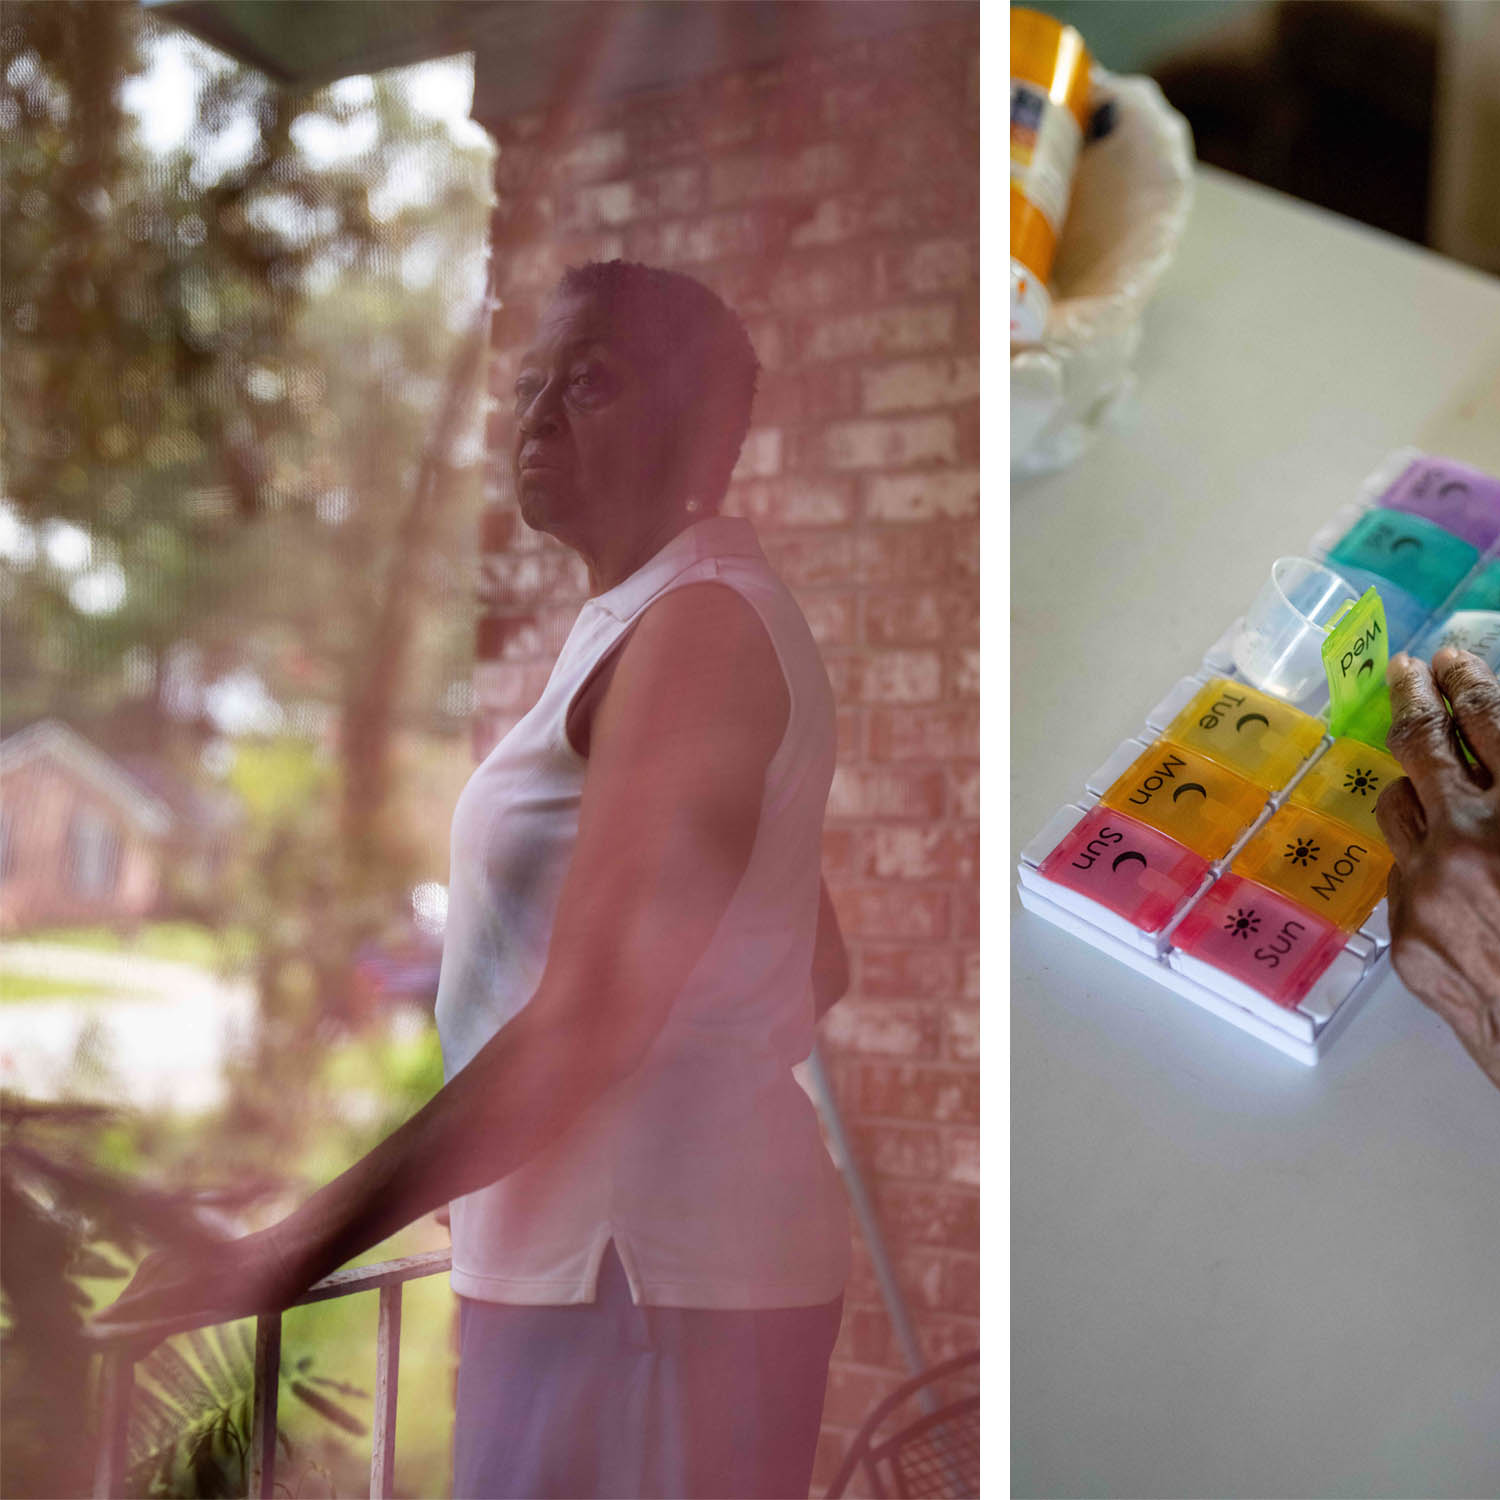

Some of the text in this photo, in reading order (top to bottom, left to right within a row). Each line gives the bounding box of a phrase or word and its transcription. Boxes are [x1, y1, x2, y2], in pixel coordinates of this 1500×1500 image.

[1340, 620, 1382, 678] Wed
[1199, 693, 1246, 730] Tue
[1129, 754, 1187, 805] Mon
[1072, 827, 1123, 870] Sun
[1310, 844, 1368, 901] Mon
[1254, 920, 1305, 968] Sun
